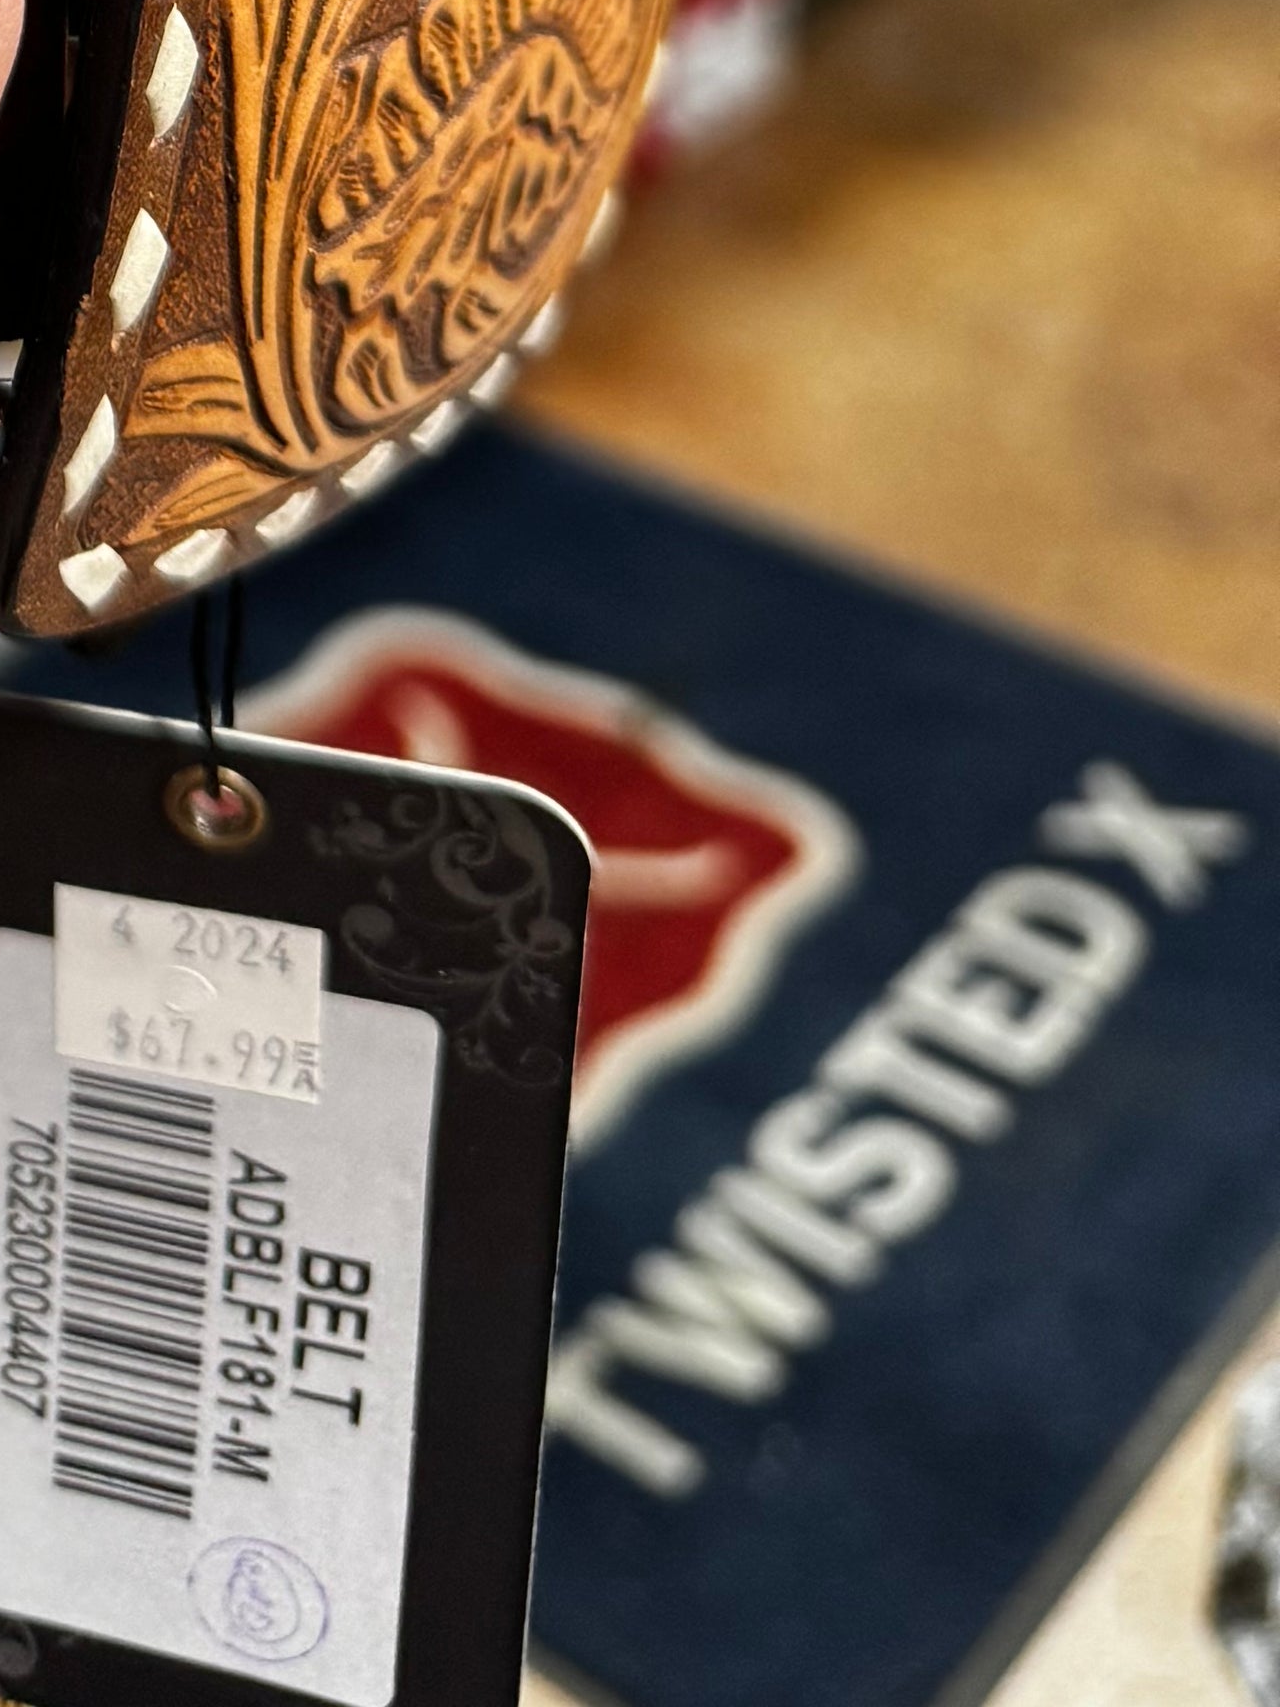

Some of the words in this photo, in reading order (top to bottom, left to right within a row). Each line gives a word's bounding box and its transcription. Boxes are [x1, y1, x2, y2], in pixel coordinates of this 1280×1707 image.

[108, 1007, 288, 1086] $67.99
[171, 911, 293, 975] 2024
[545, 863, 1151, 1497] TWISTED
[1042, 759, 1248, 911] X
[0, 1117, 60, 1419] 705230004407
[211, 1147, 289, 1483] ADBLF181-M
[290, 1245, 372, 1427] BELT
